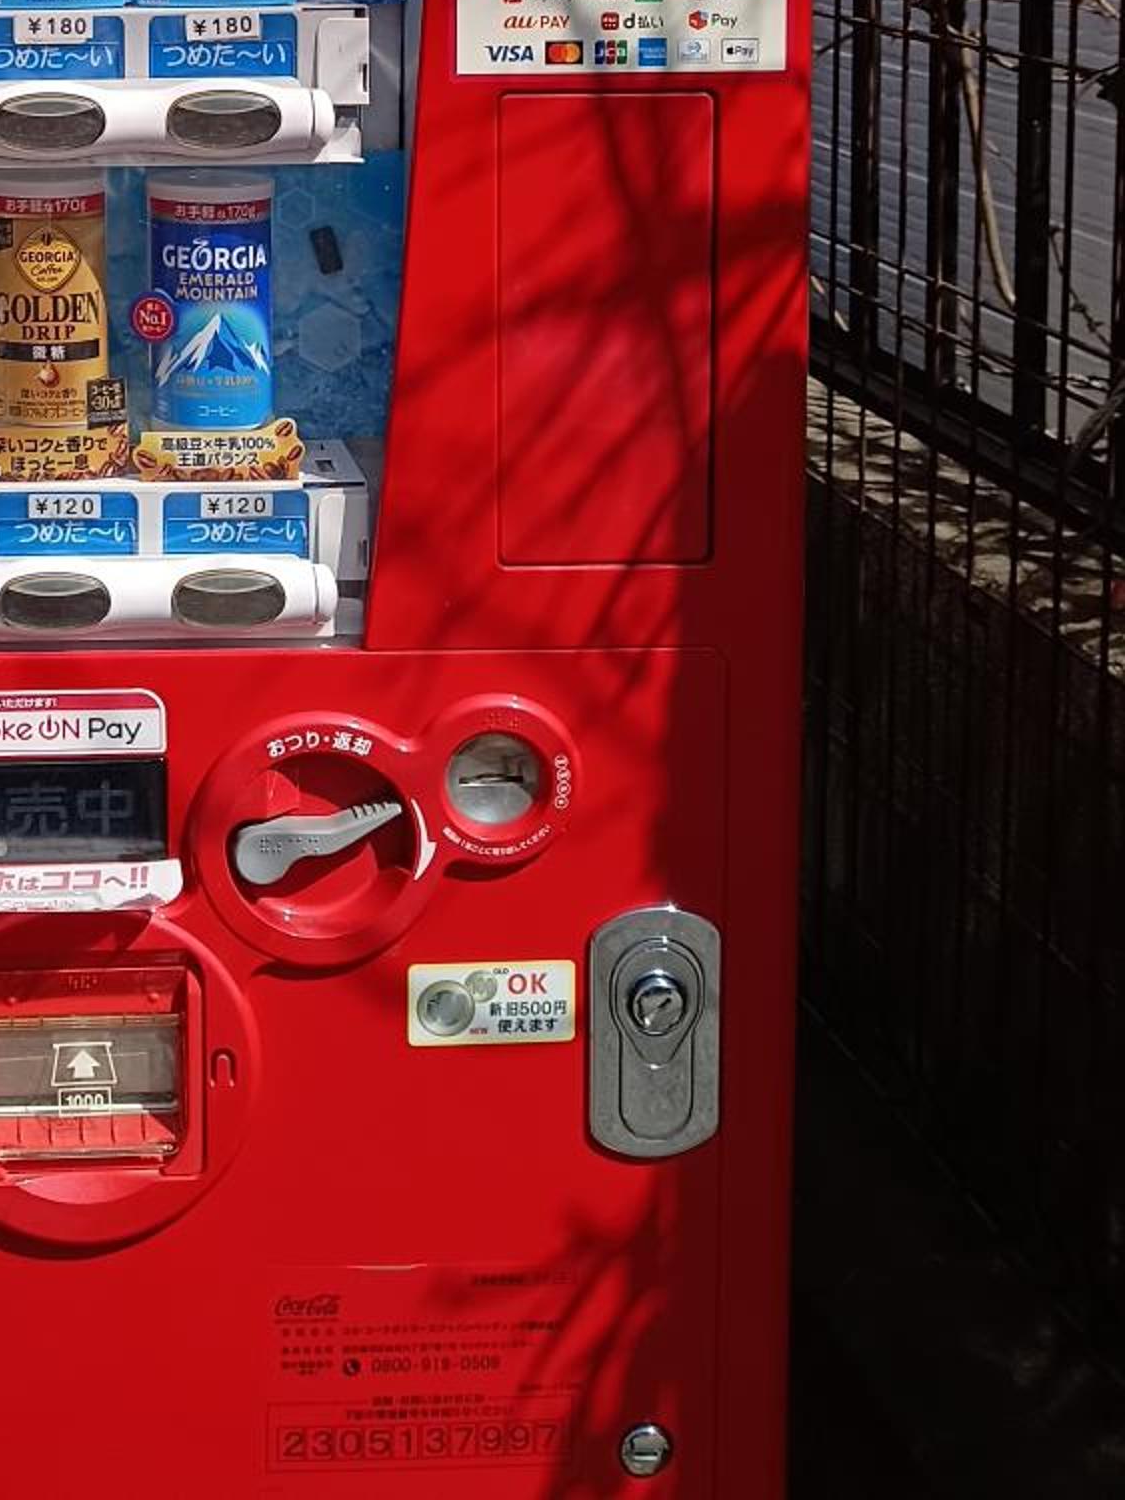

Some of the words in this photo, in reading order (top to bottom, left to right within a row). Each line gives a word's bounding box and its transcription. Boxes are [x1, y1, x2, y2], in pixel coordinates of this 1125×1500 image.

[540, 15, 571, 29] PAY
[710, 14, 739, 29] Pay
[484, 45, 535, 63] VISA
[734, 45, 756, 59] Pay
[179, 271, 254, 286] EMERALD
[175, 285, 259, 302] MOUNTAIN
[22, 325, 76, 341] DRIP
[198, 405, 239, 418] コーヒー
[10, 453, 91, 472] ほっと一息
[177, 452, 260, 468] 王道バランス
[38, 714, 81, 741] ON
[87, 716, 143, 745] Pay
[266, 729, 374, 760] おつり・返却
[507, 973, 548, 995] OK
[497, 1018, 559, 1033] 使えます
[65, 1093, 105, 1109] 1000
[282, 1424, 560, 1460] 2305137997
